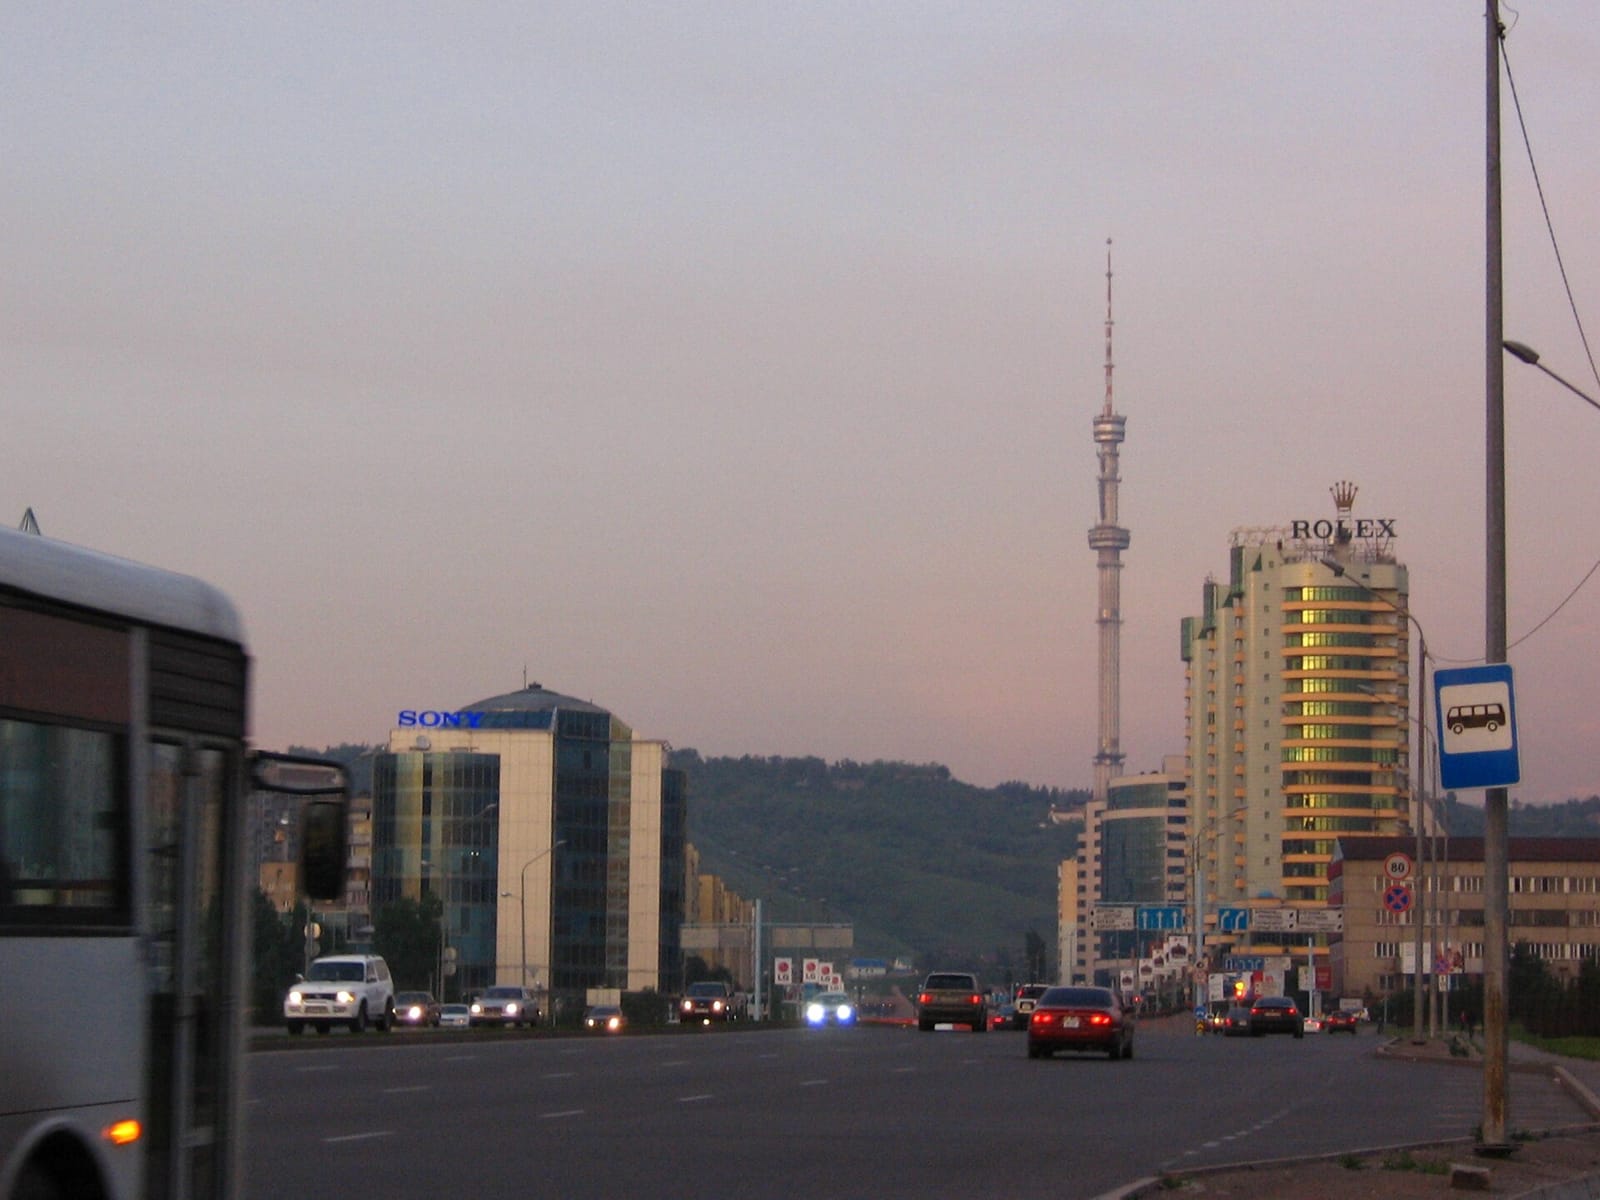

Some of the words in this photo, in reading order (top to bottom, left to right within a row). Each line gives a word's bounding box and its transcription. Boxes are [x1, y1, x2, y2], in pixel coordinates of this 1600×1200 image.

[1291, 519, 1398, 539] ROLEX
[398, 710, 485, 728] SONY
[1391, 862, 1405, 873] 80
